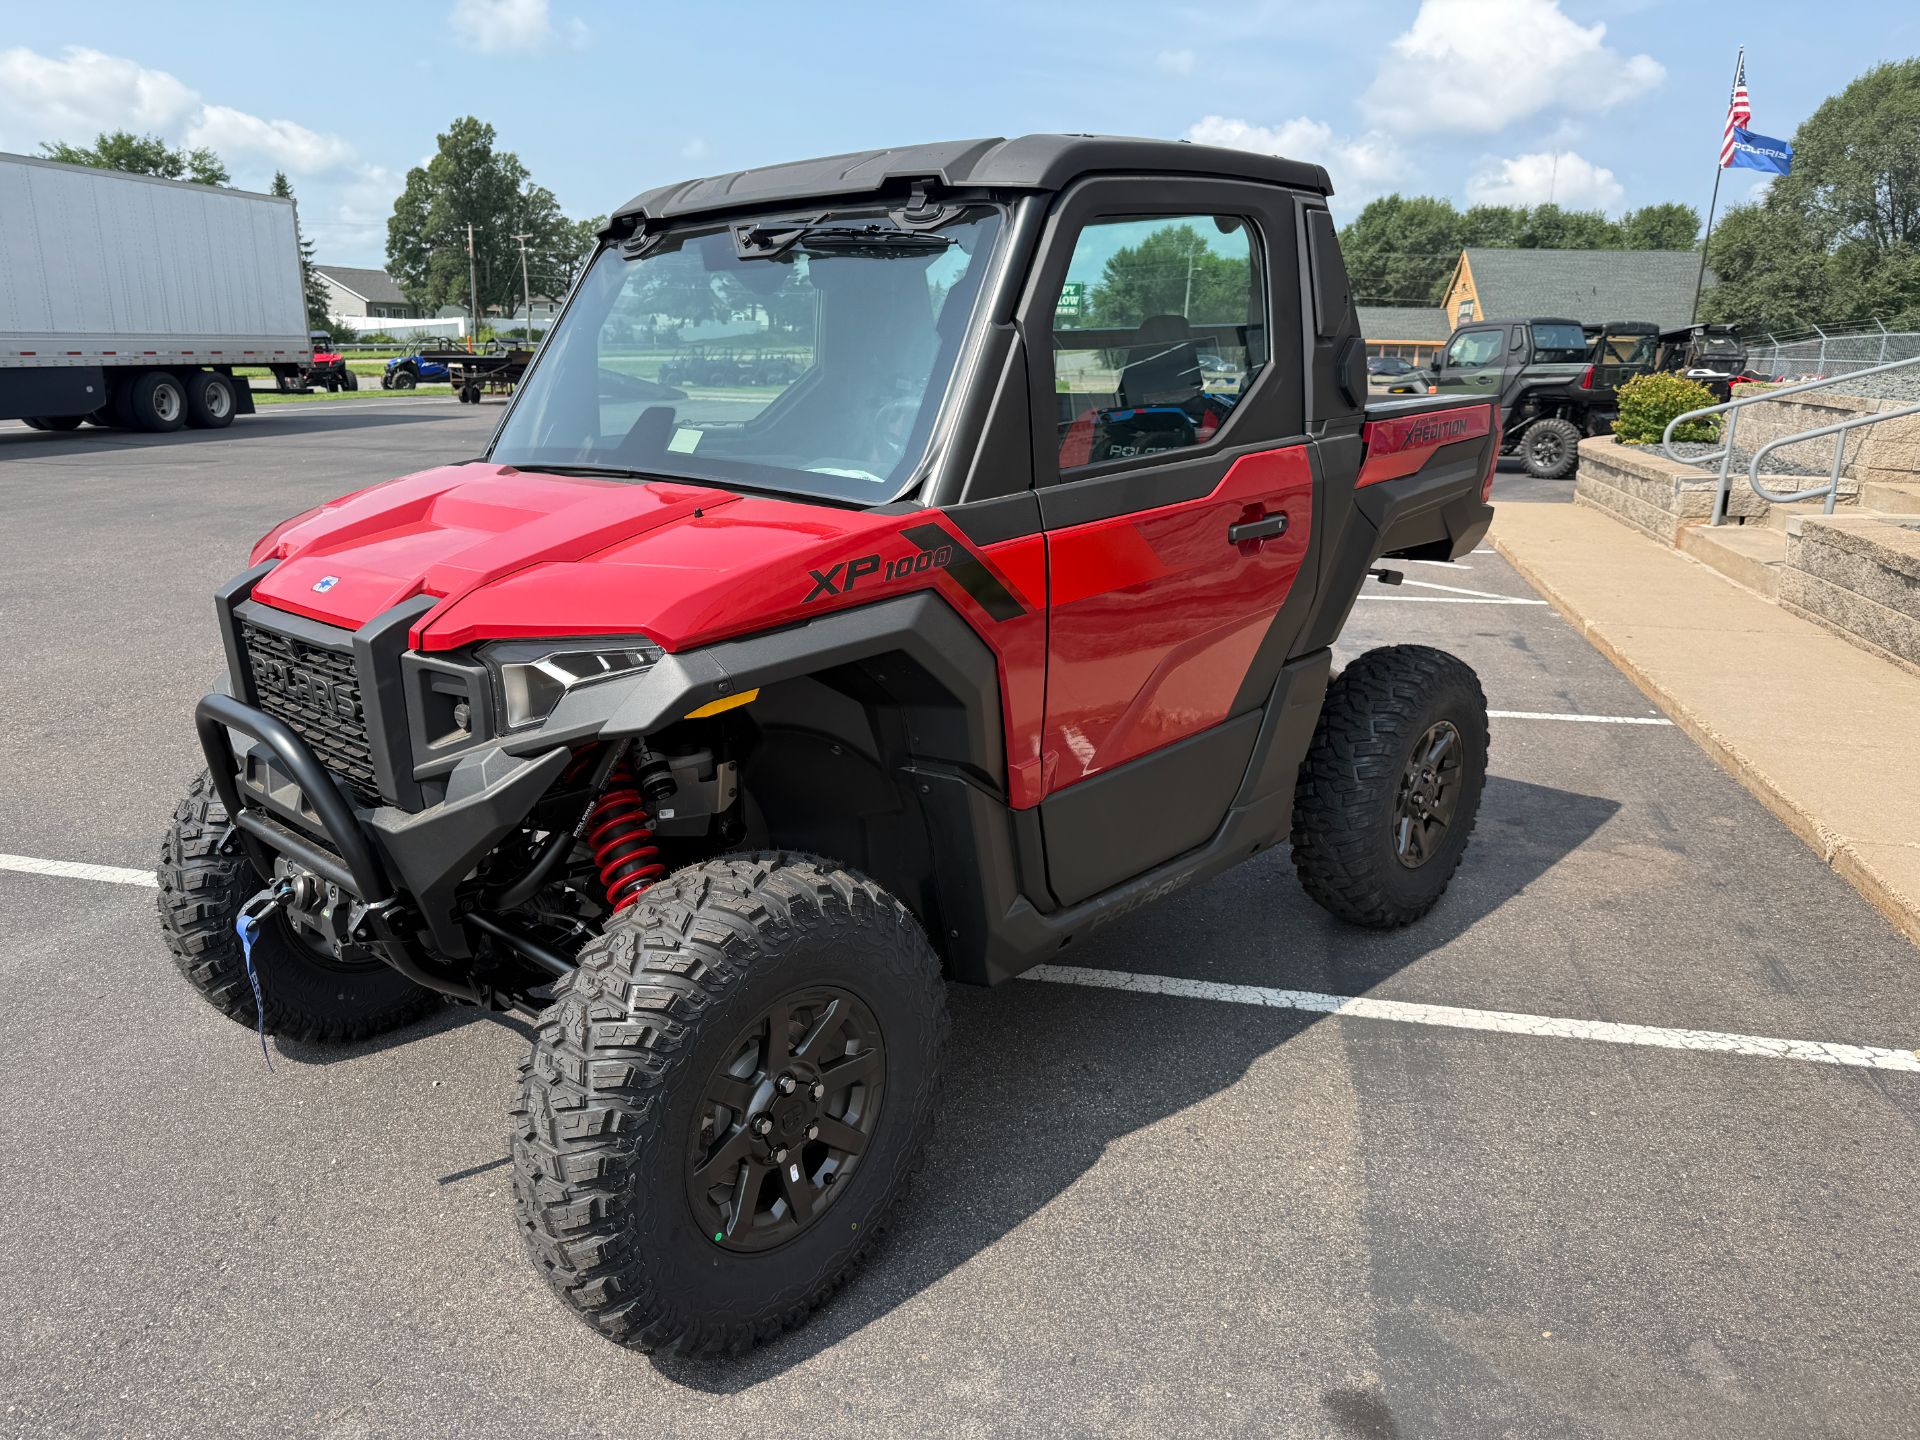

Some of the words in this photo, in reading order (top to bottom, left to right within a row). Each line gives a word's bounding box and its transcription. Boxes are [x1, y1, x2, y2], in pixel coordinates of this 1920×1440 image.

[1733, 142, 1788, 160] POLARIS
[1401, 420, 1468, 450] XPEDITION
[801, 553, 880, 604] XP
[884, 545, 953, 582] 1000
[250, 654, 357, 717] POLARIS
